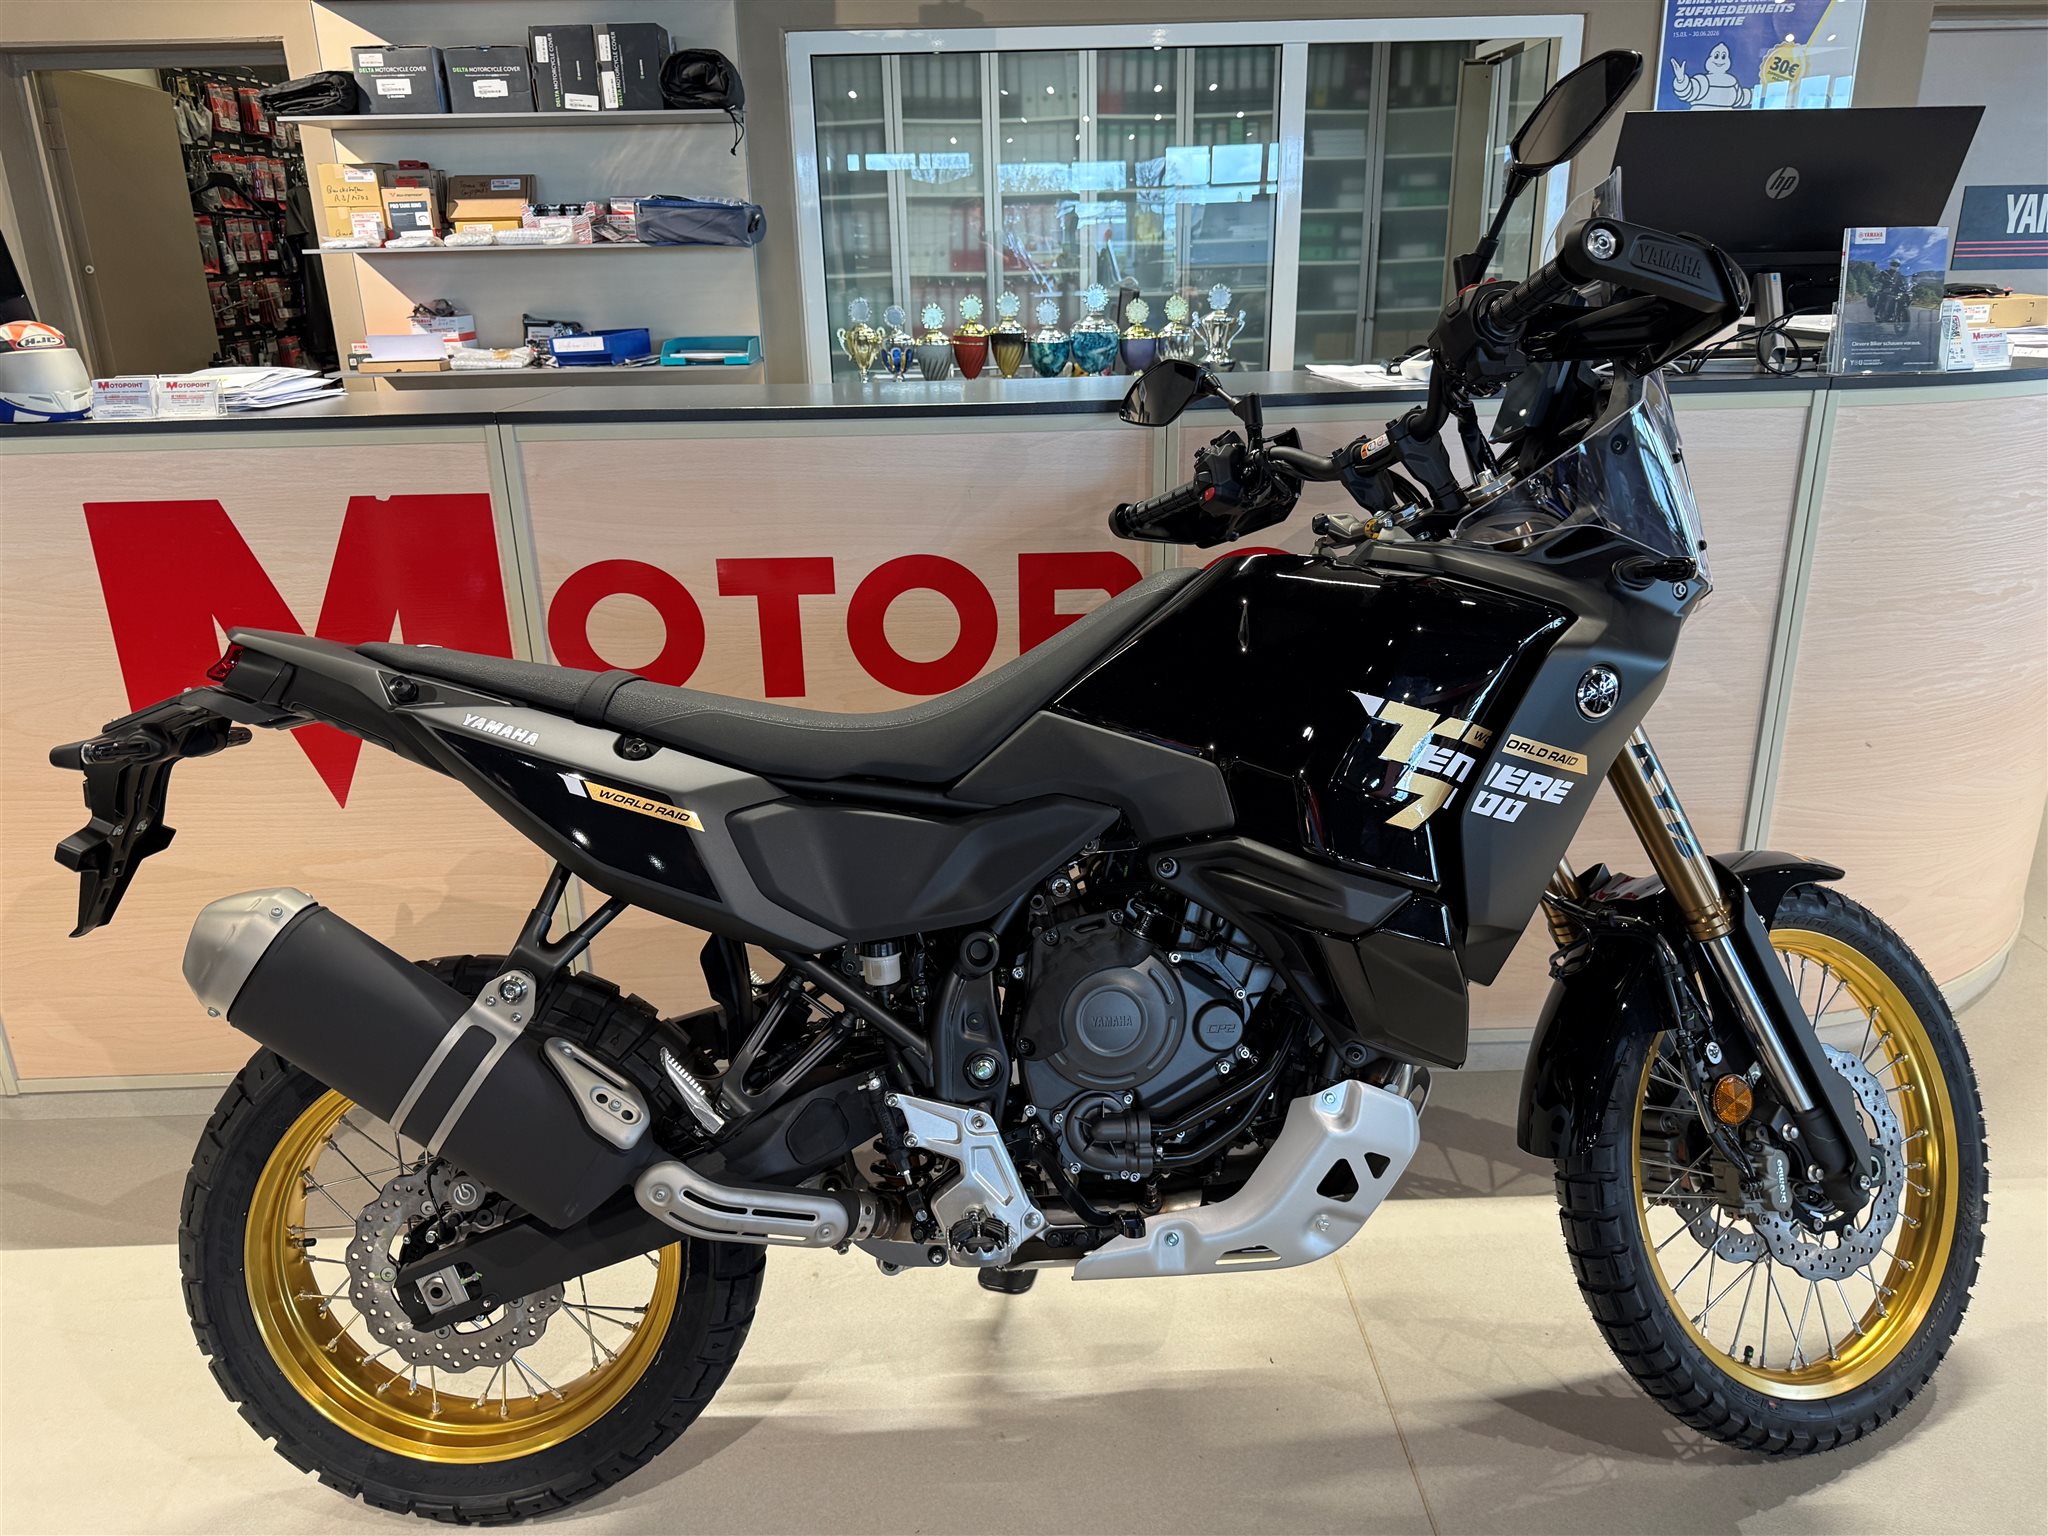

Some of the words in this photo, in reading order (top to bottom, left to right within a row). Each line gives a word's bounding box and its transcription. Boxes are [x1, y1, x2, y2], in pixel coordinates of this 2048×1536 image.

[1675, 3, 1795, 16] ZUFRIEDENHEITS
[1674, 16, 1745, 28] GARANTIE
[1770, 56, 1799, 78] 30€
[1767, 168, 1798, 199] hp
[1639, 244, 1702, 279] YAMAHA
[24, 336, 57, 346] HJC
[98, 381, 143, 391] MOTOPOINT
[166, 381, 210, 391] MOTOPOINT
[462, 713, 540, 747] YAMAHA
[1548, 751, 1579, 766] RAID
[599, 789, 655, 811] WORLD
[655, 806, 691, 822] RAID
[1091, 1015, 1133, 1028] YAMAHA
[1206, 1023, 1237, 1034] CP2
[1776, 1159, 1788, 1204] brembo
